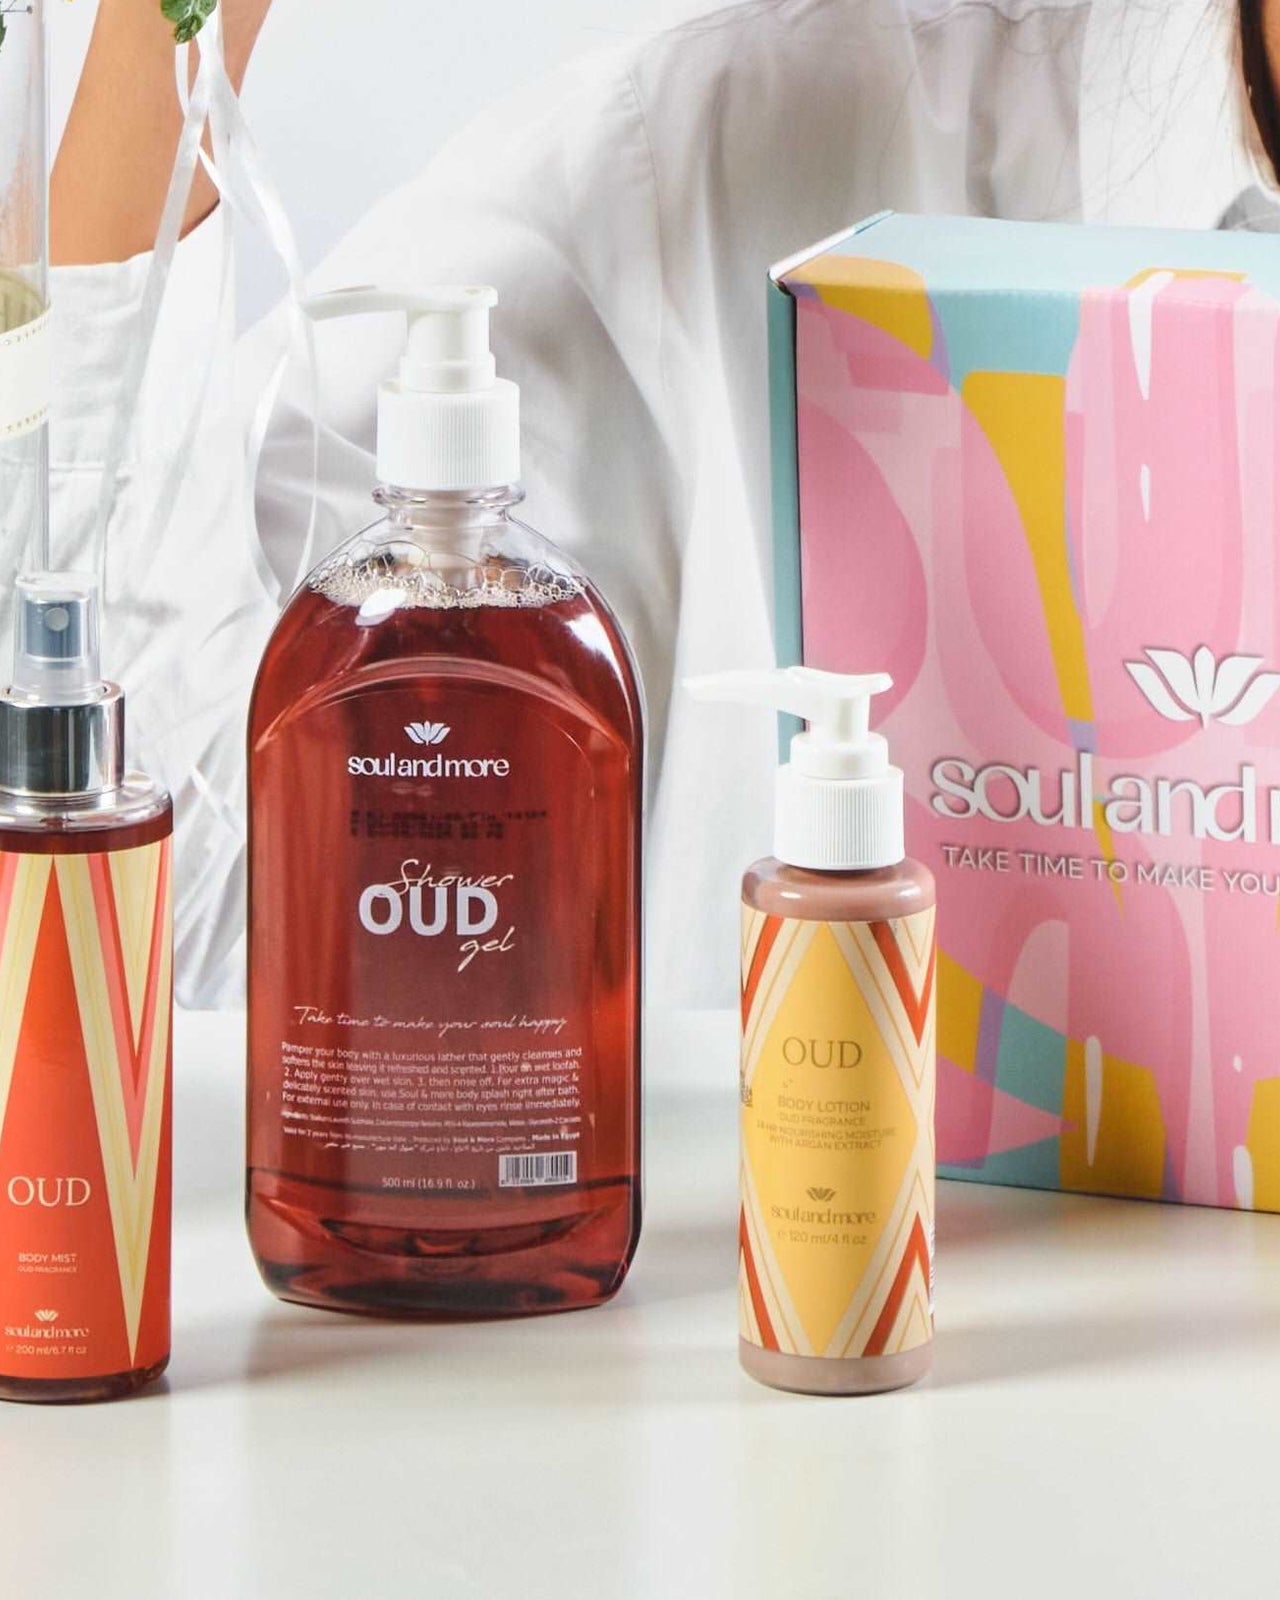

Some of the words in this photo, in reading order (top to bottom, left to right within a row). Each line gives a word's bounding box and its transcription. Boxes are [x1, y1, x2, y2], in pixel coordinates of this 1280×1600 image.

[383, 858, 514, 898] Shower
[941, 845, 1010, 873] TAKE
[1018, 851, 1084, 881] TIME
[1090, 858, 1129, 884] TO
[1136, 861, 1216, 892] MAKE
[358, 884, 499, 936] OUD
[457, 926, 515, 972] gel
[293, 1004, 333, 1026] Take
[518, 1014, 568, 1036] happy
[565, 1046, 583, 1058] and
[782, 1036, 863, 1070] OUD
[777, 1094, 814, 1111] BODY
[817, 1100, 871, 1113] LOTION
[8, 1175, 92, 1207] OUD
[382, 1177, 400, 1188] 500
